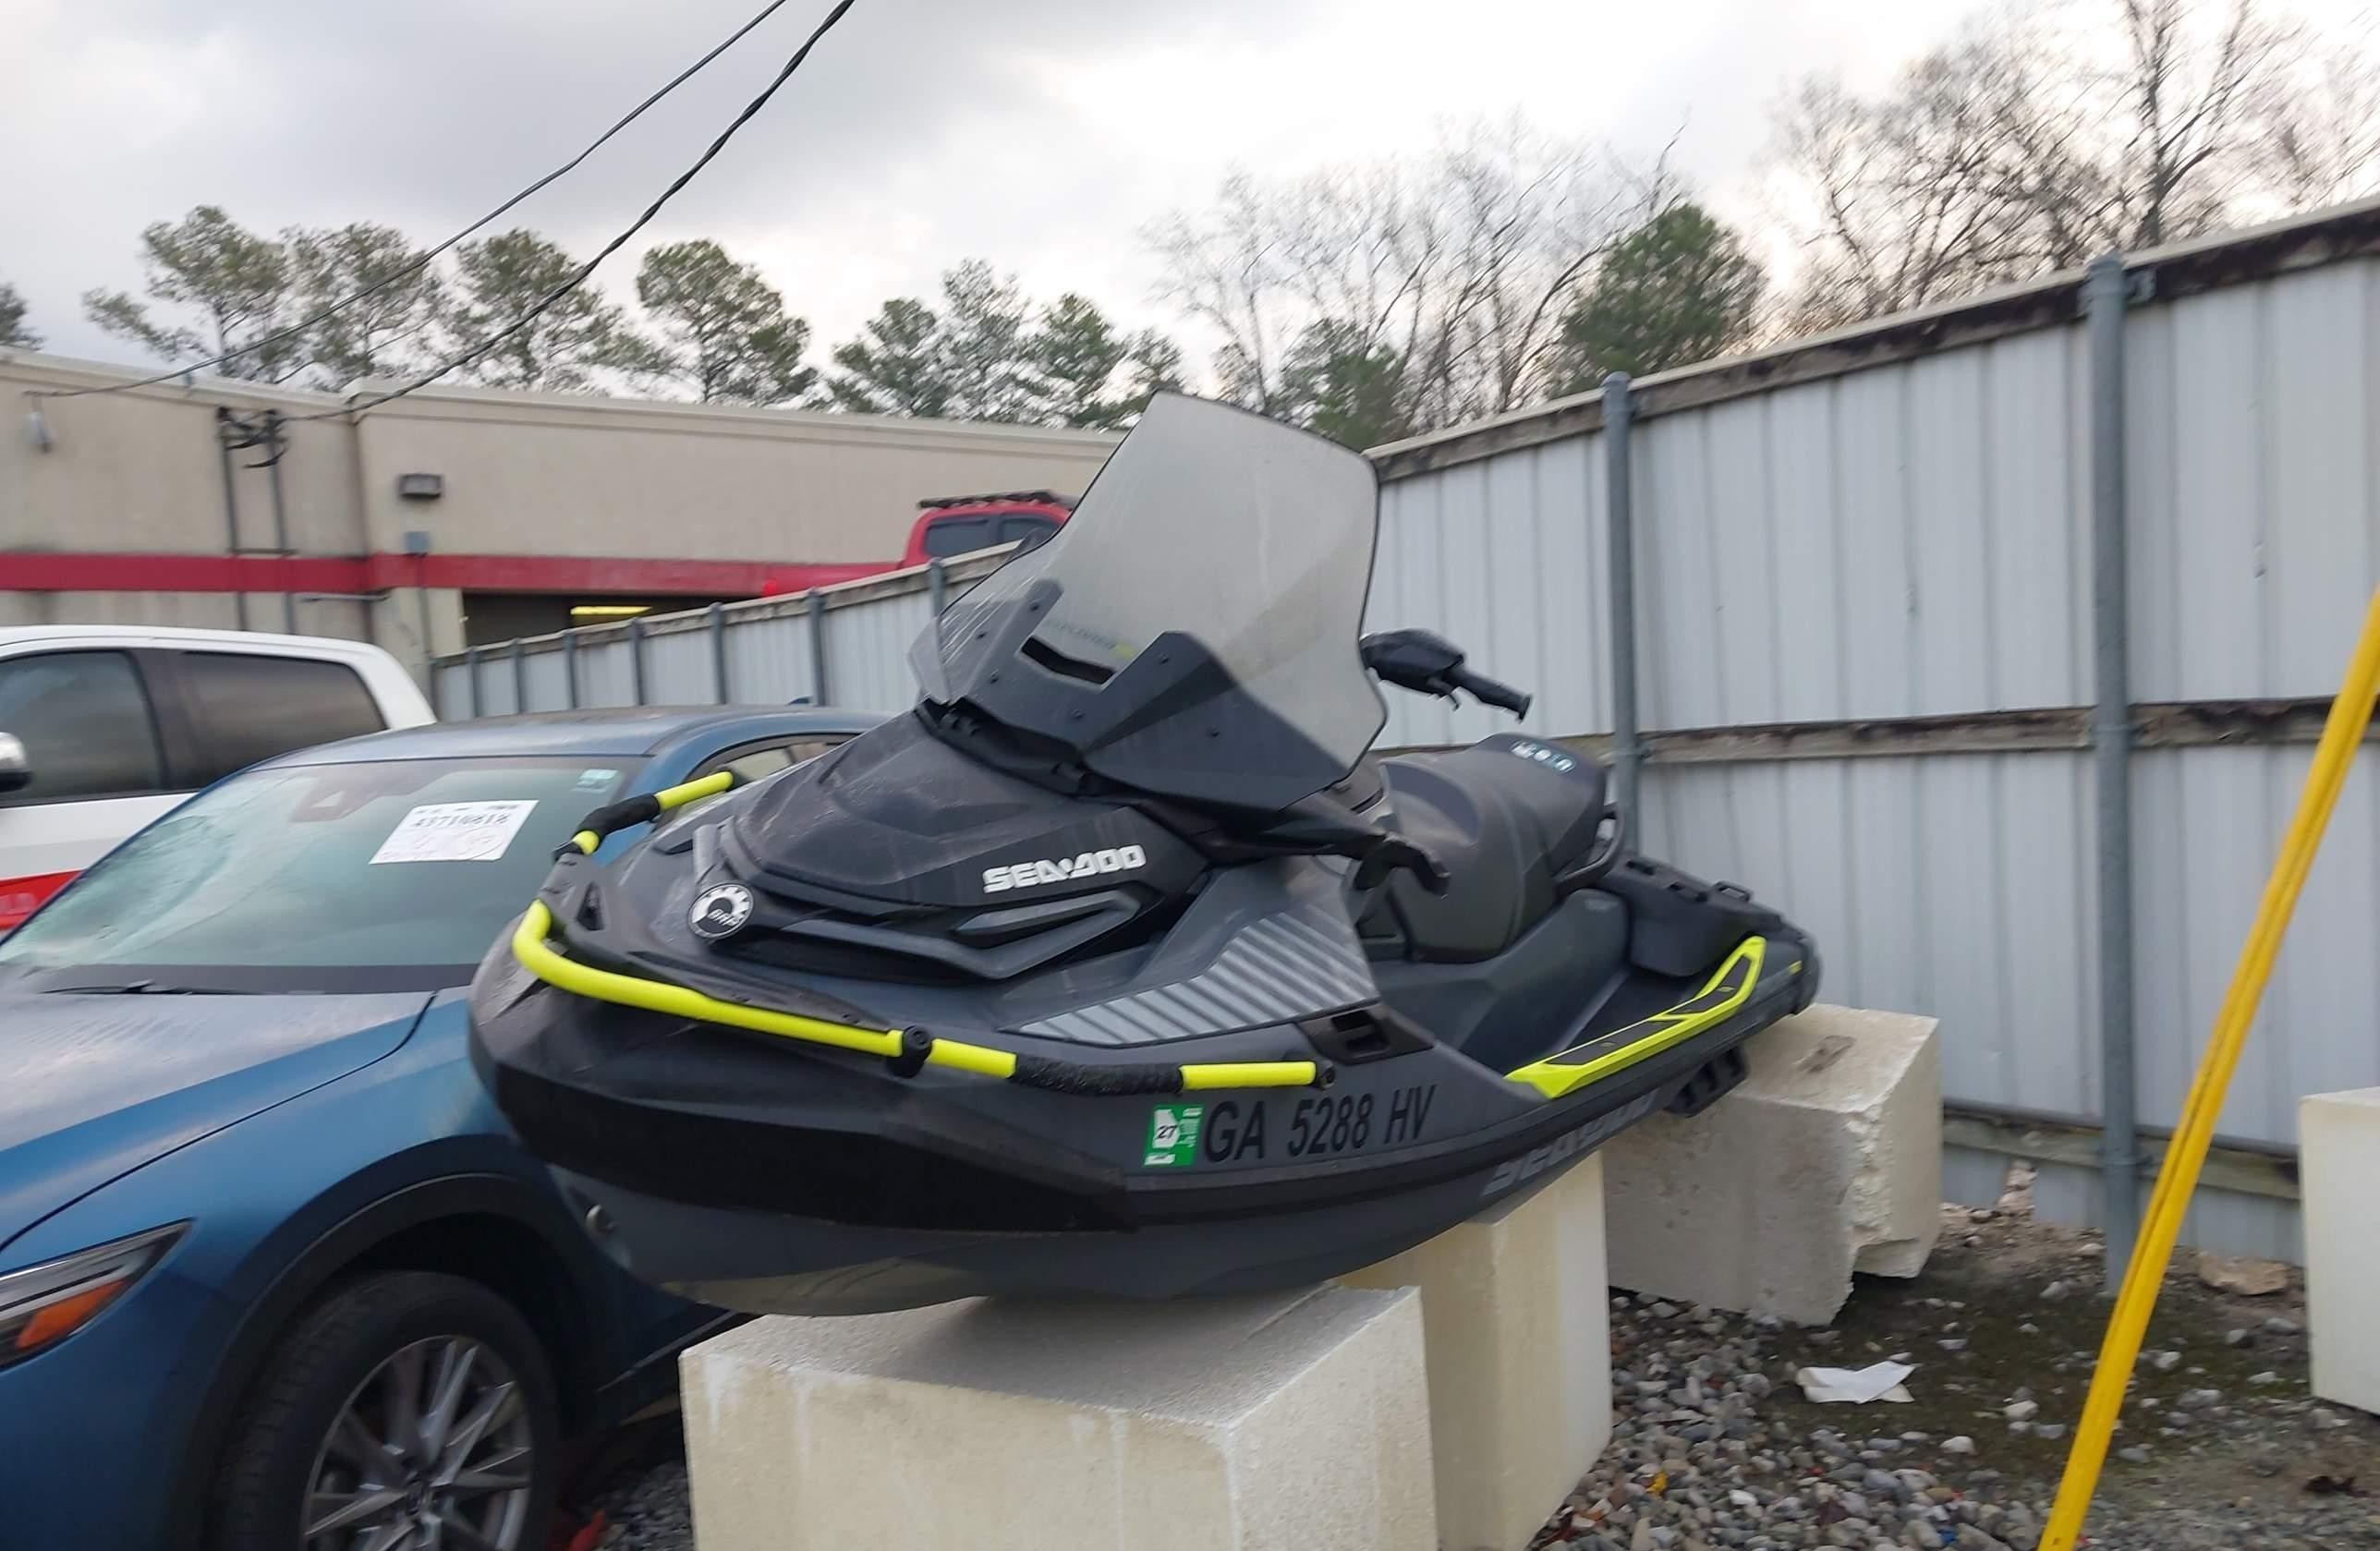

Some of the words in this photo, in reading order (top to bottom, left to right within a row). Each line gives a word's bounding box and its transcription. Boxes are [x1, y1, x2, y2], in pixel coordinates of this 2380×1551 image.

[1157, 1125, 1178, 1140] 27
[1205, 1100, 1266, 1163] GA
[1288, 1094, 1374, 1157] 5288
[1384, 1084, 1436, 1145] HV
